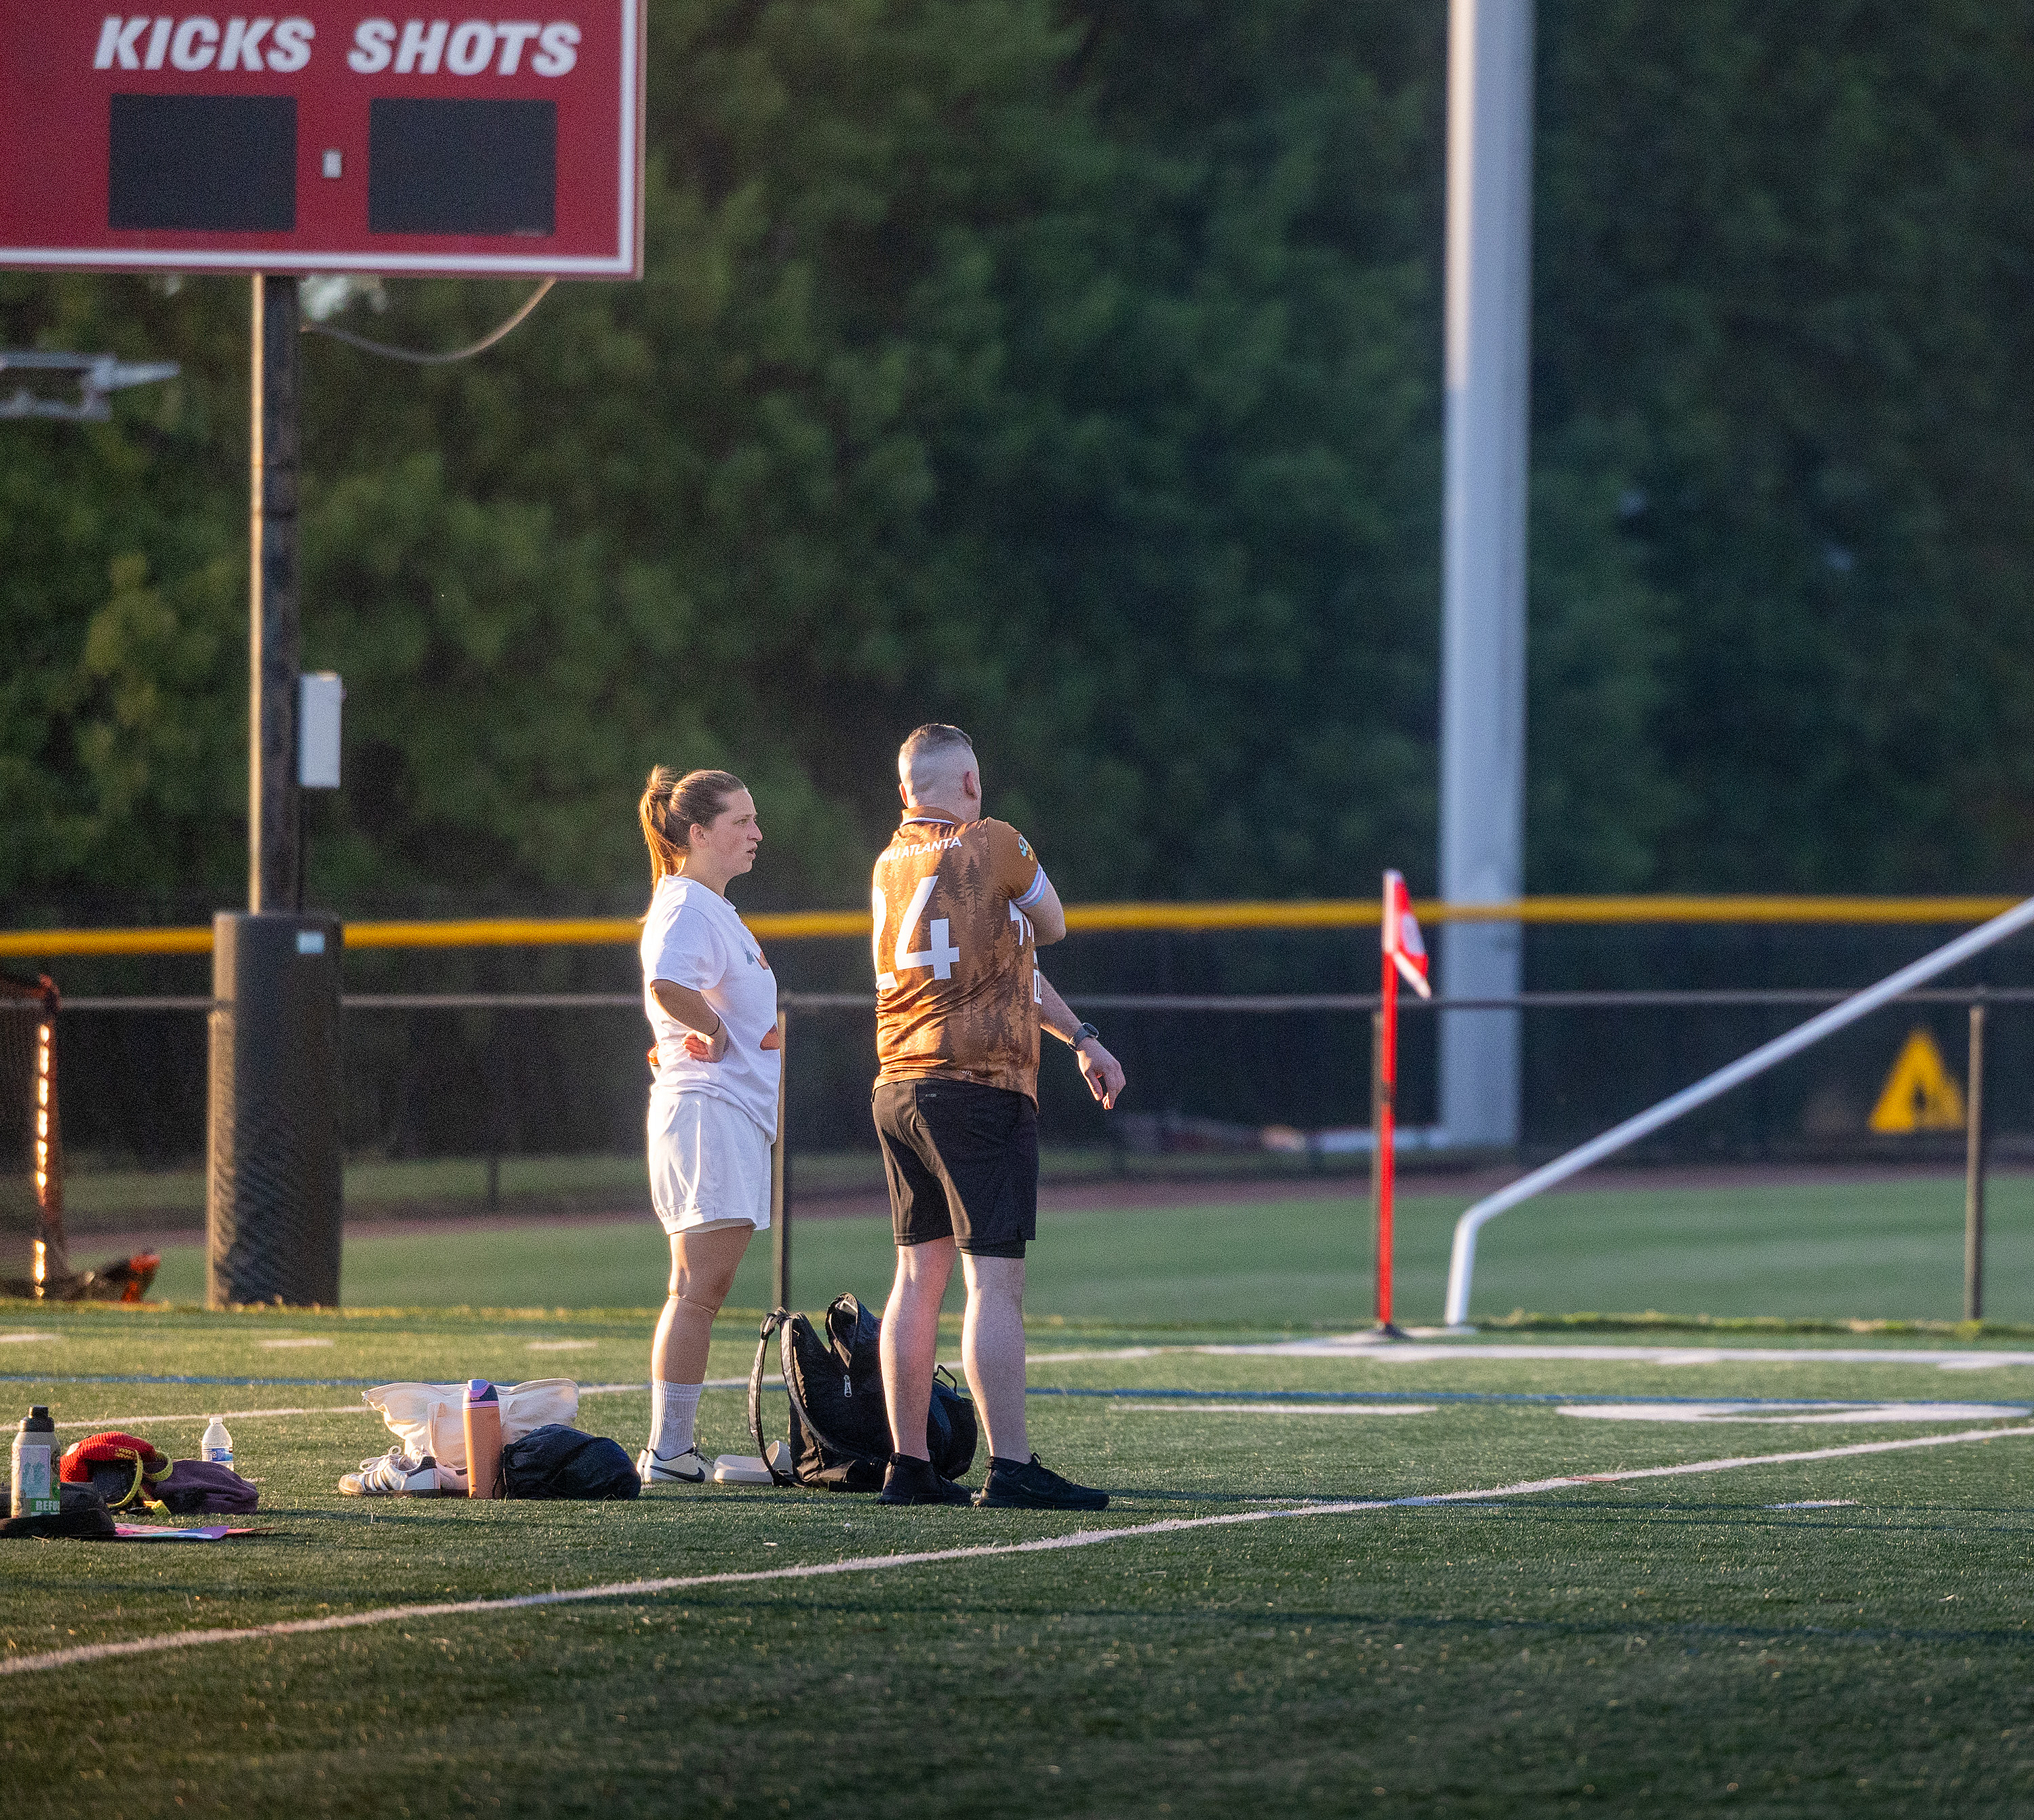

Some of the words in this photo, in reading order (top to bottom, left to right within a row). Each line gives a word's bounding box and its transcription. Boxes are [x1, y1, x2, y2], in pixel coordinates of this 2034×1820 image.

[94, 16, 317, 73] KICKS
[346, 18, 582, 77] SHOTS
[900, 836, 963, 858] ATLANTA
